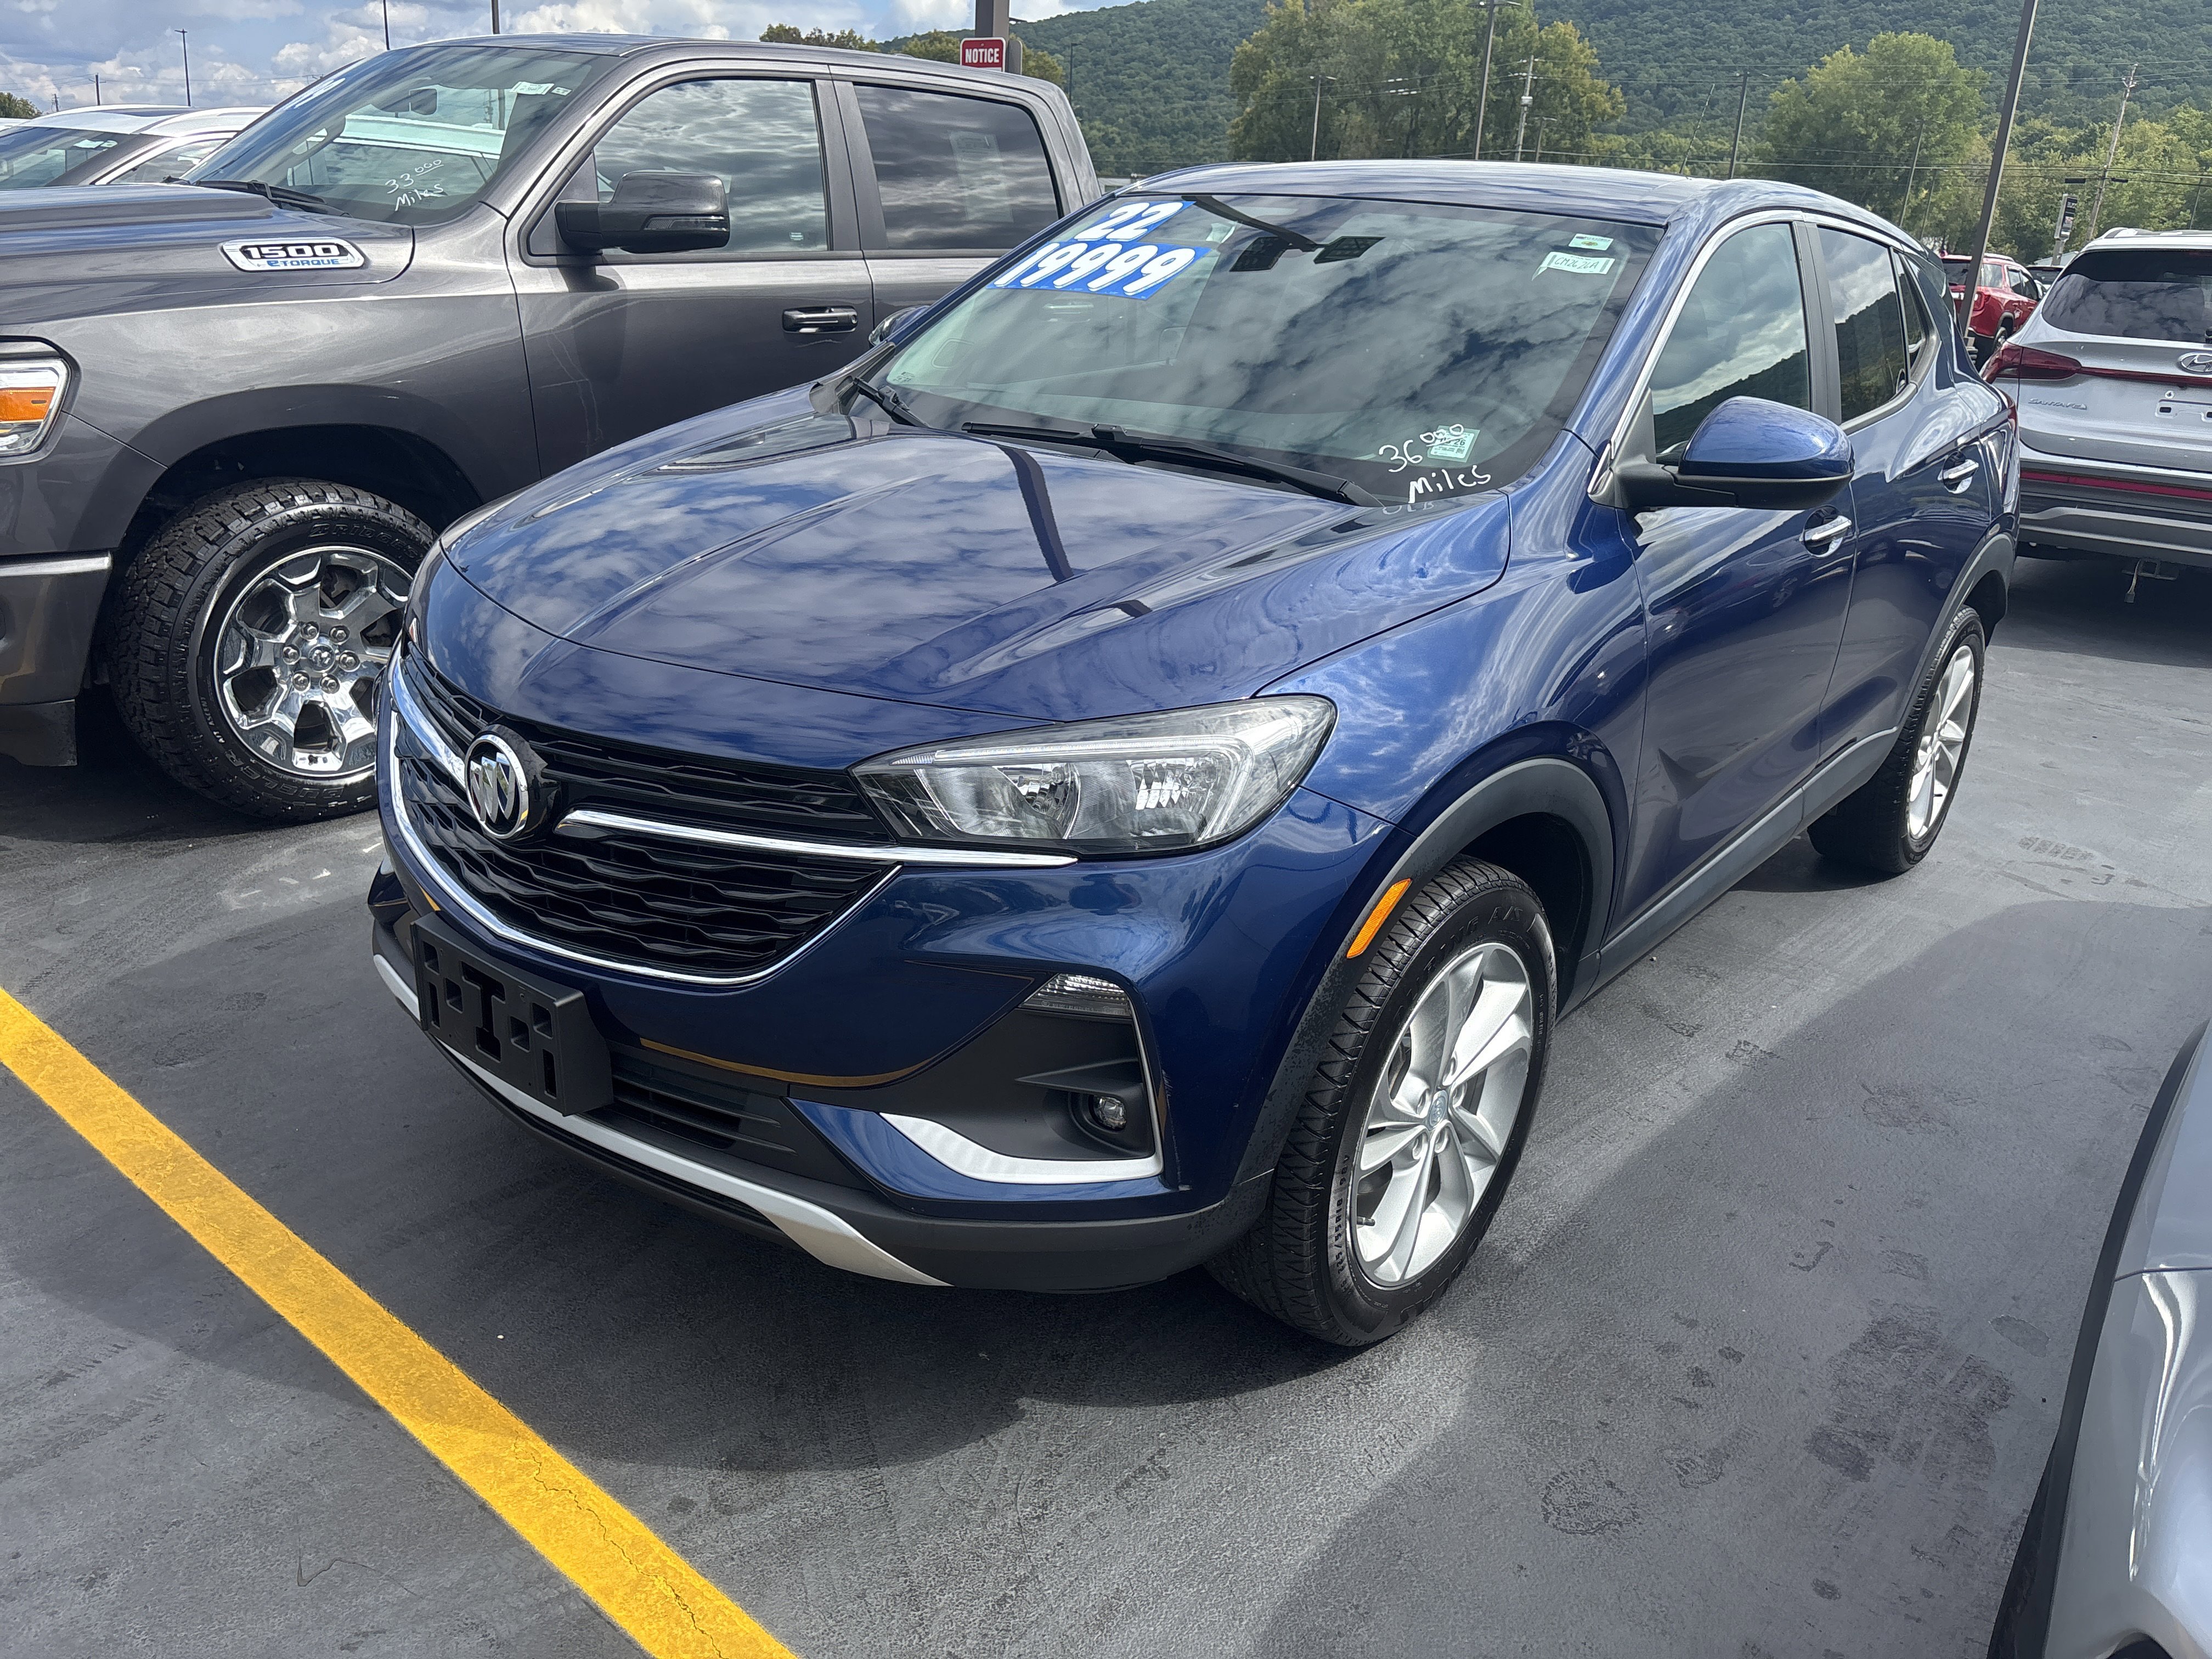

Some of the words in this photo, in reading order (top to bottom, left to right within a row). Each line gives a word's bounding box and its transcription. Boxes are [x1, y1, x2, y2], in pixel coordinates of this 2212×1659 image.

[966, 48, 1000, 64] NOTICE
[394, 183, 444, 212] Miles
[1074, 202, 1183, 242] 22
[246, 245, 340, 259] 1500
[266, 259, 340, 267] eTORQUE
[994, 242, 1197, 296] 19999
[1379, 439, 1423, 472] 36
[1408, 465, 1492, 504] Miles
[308, 523, 424, 565] BRIDGES
